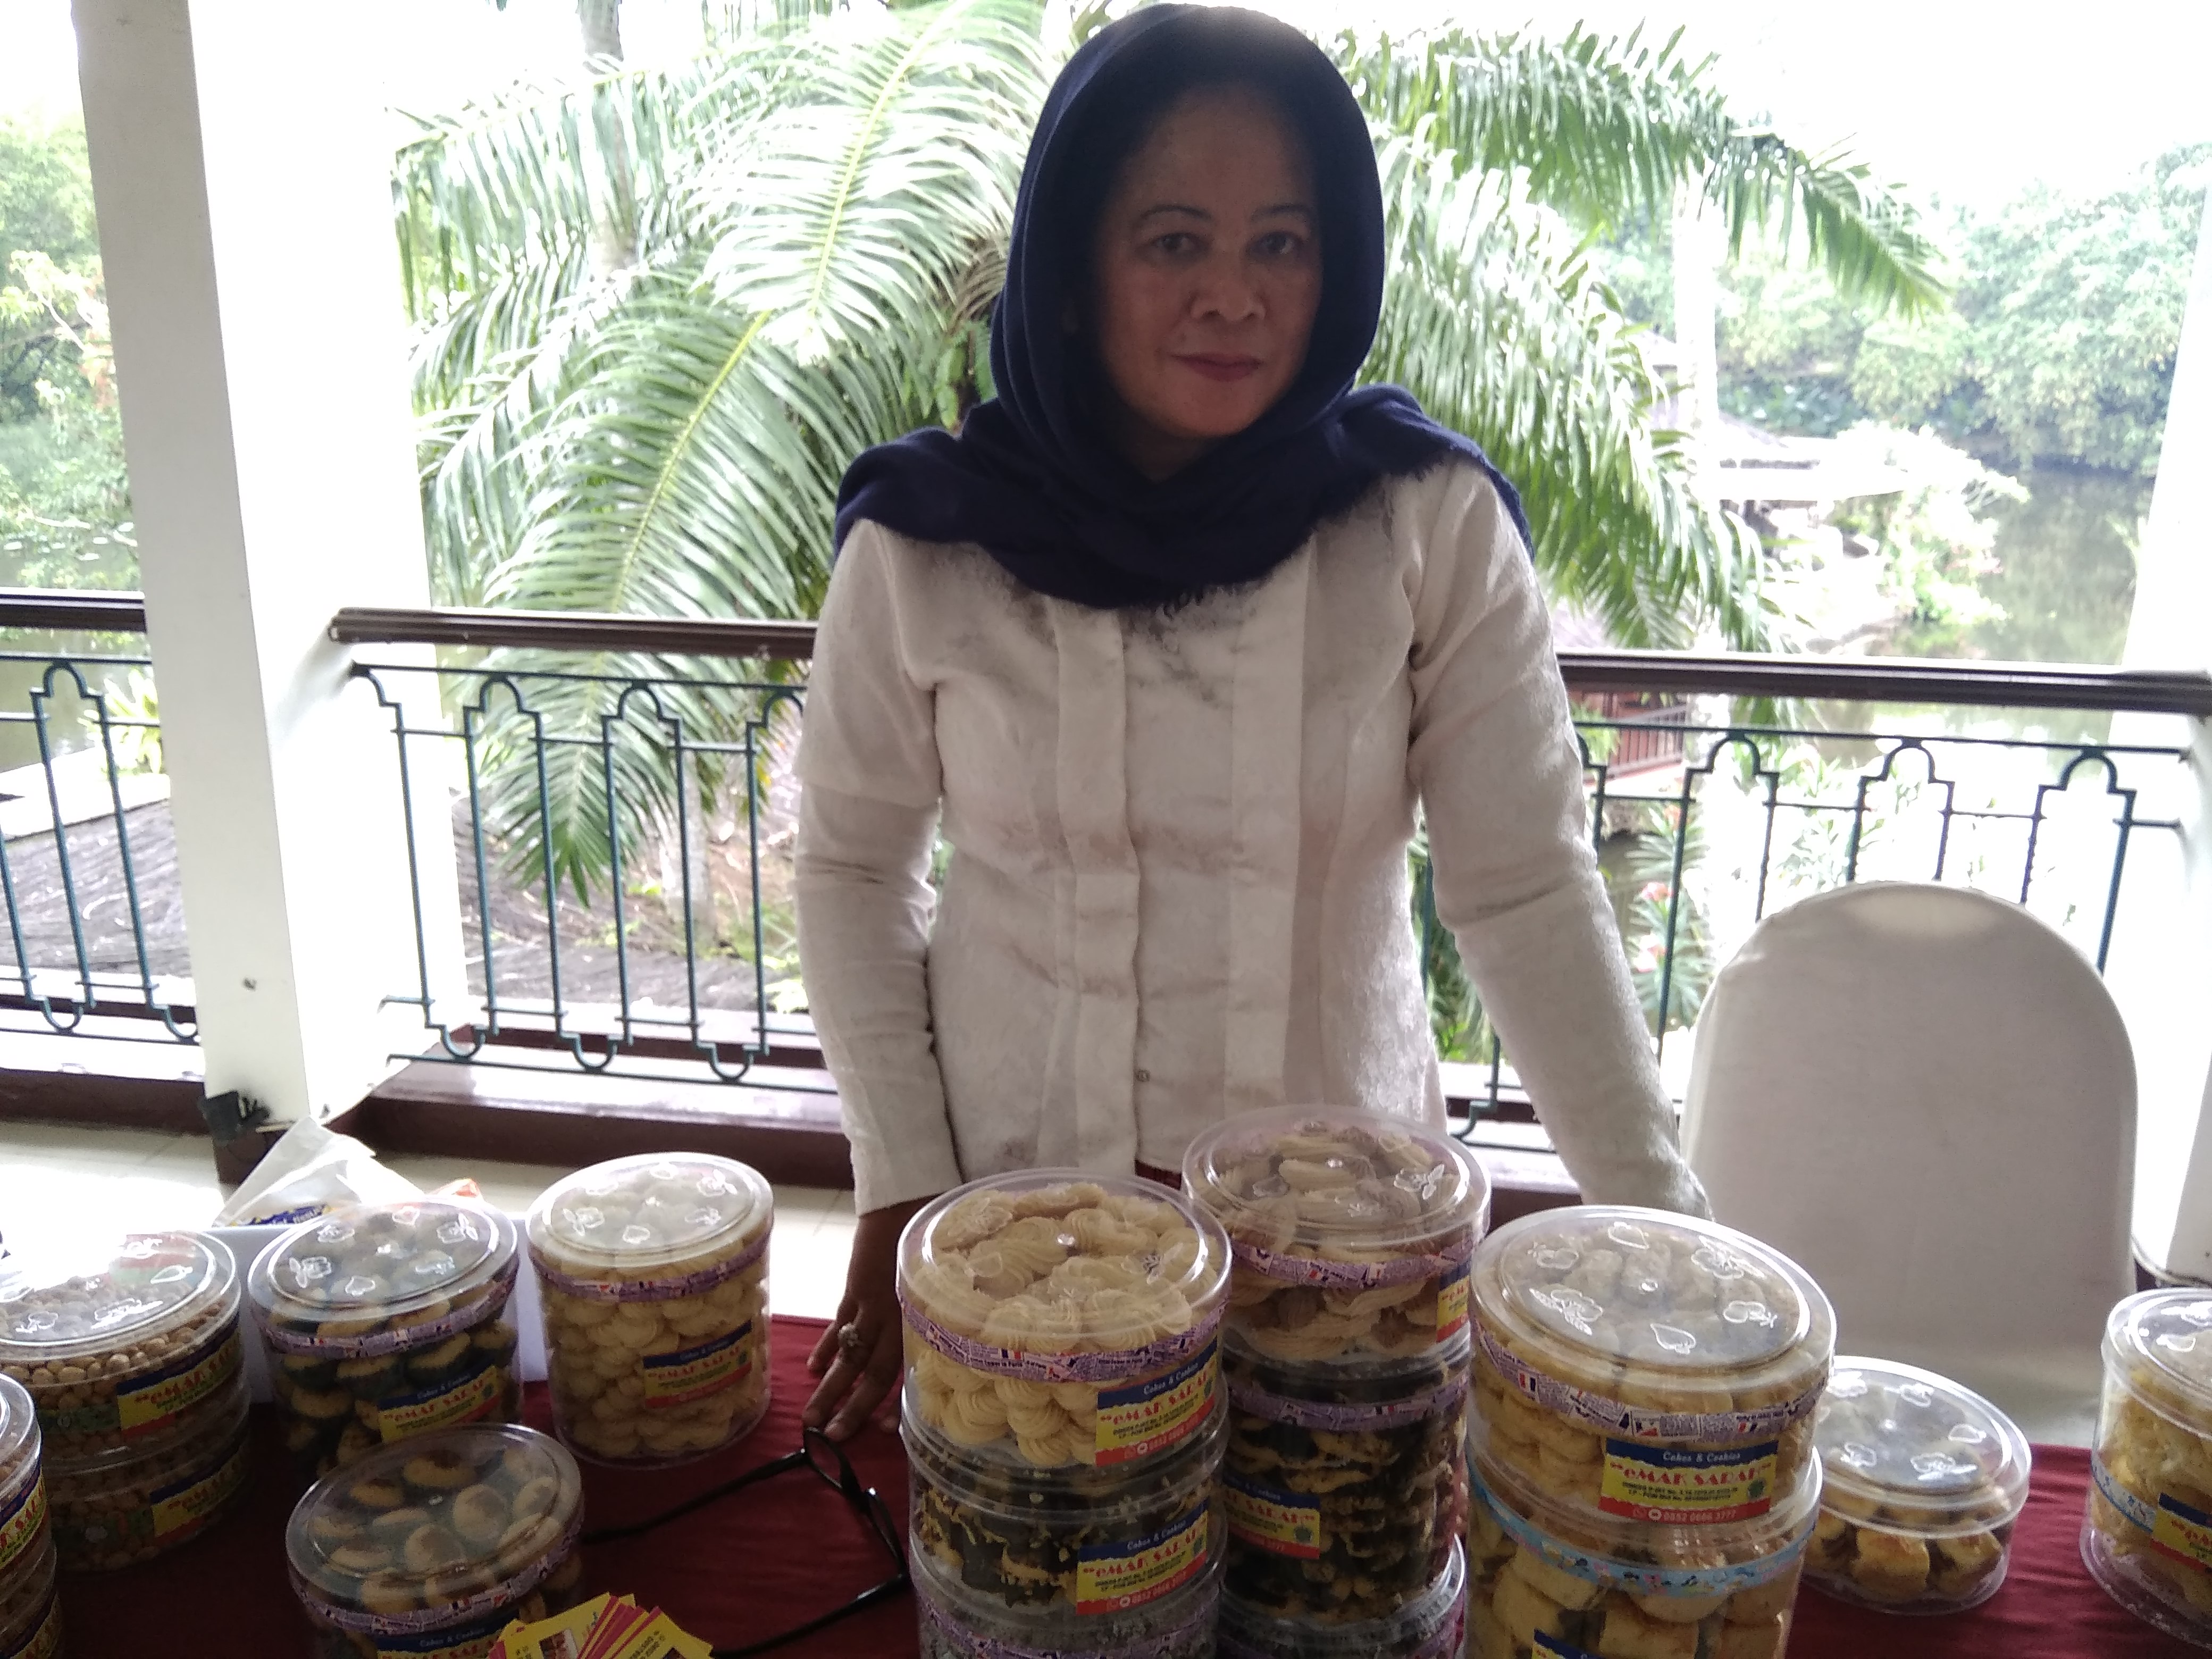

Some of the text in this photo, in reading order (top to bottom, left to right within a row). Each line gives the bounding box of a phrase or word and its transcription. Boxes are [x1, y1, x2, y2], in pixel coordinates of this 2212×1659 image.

[1144, 1363, 1199, 1395] Cakes & Cookies
[1663, 1452, 1741, 1463] Cakes & Cookies
[1127, 1520, 1187, 1550] Cakes & Cookies
[420, 1639, 443, 1647] Cakes
